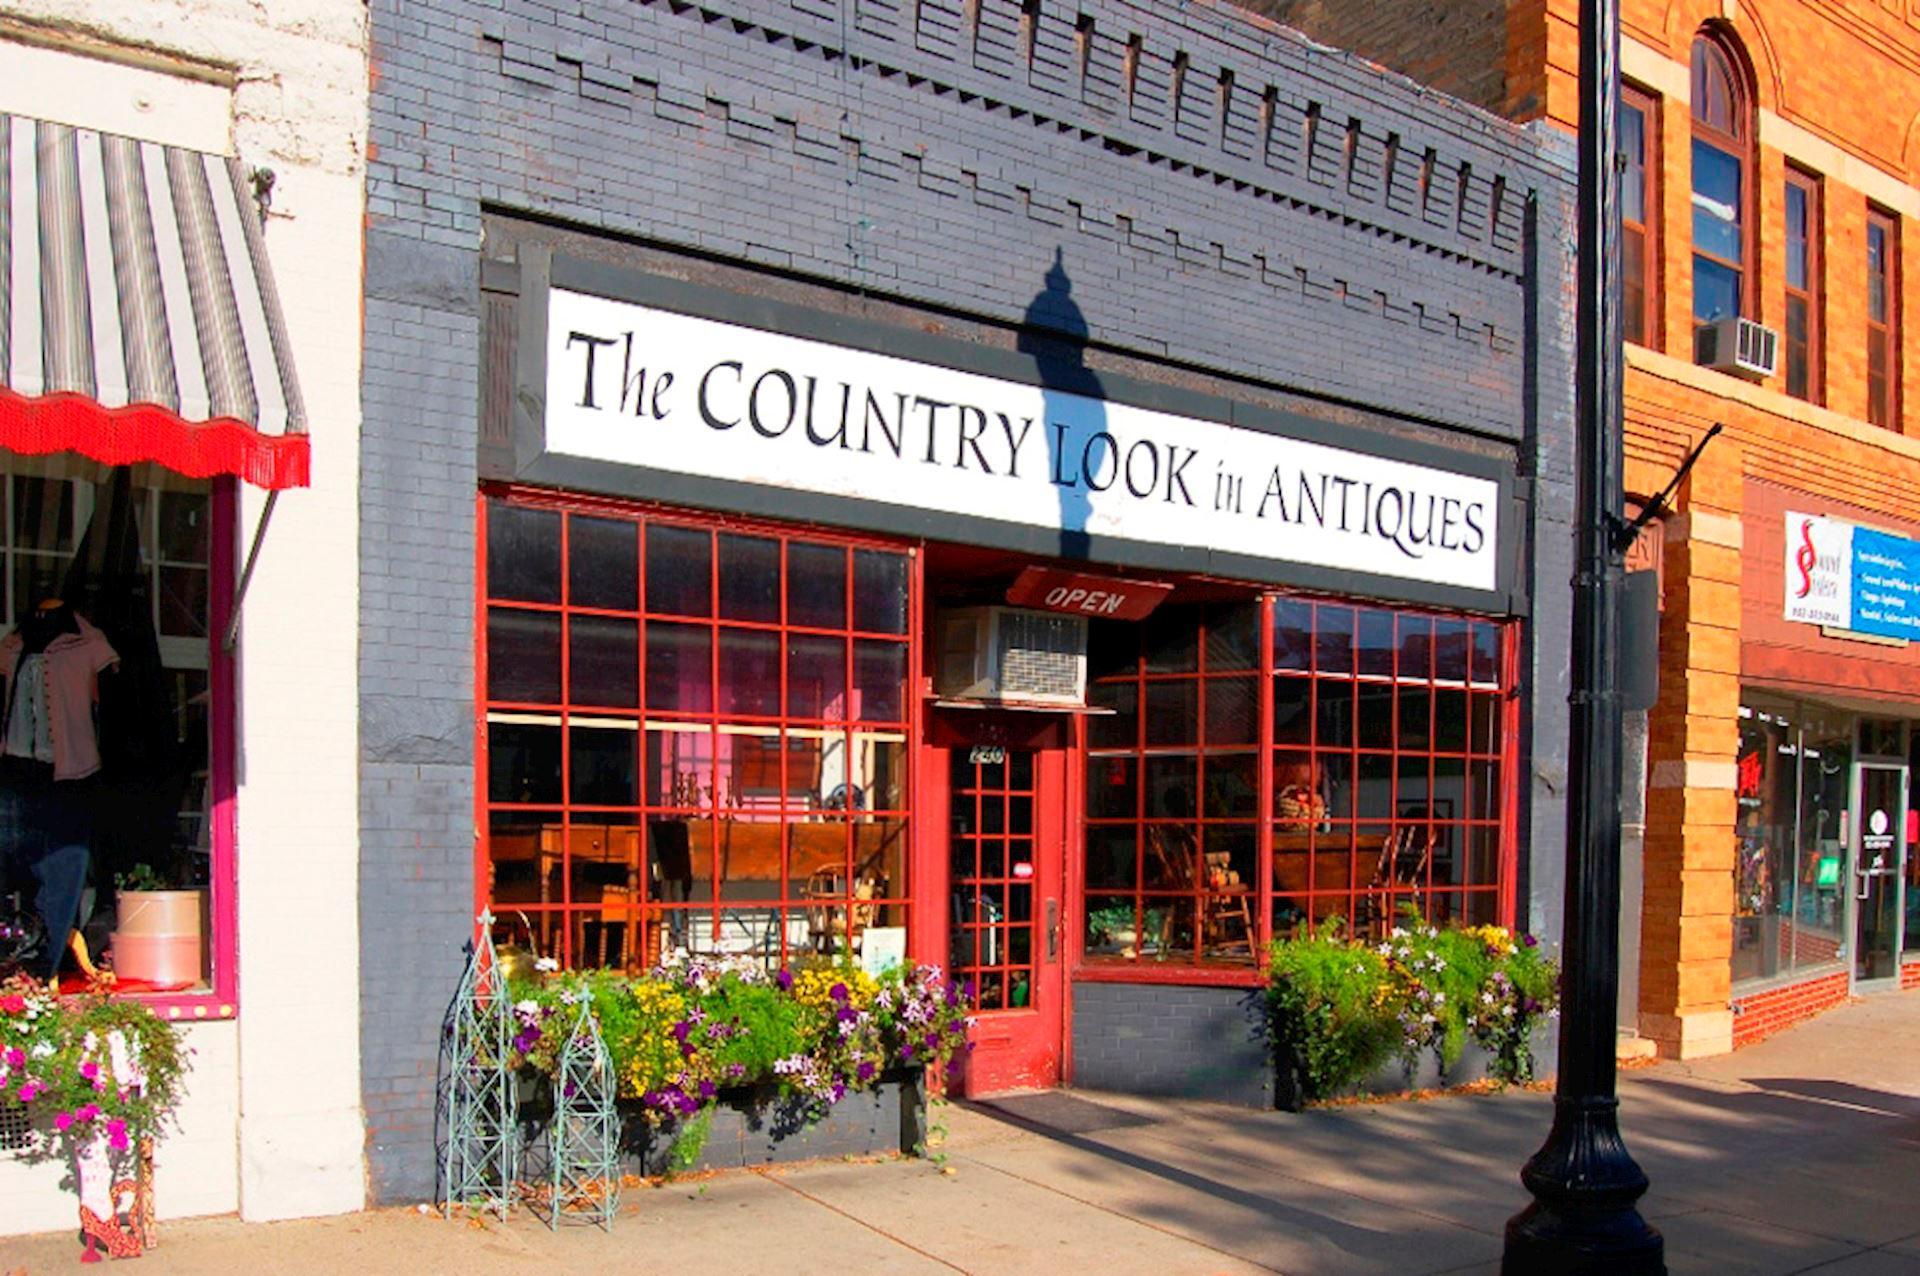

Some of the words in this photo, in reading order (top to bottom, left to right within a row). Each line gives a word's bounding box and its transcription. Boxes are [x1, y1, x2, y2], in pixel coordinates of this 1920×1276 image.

[566, 330, 674, 420] The
[698, 361, 1033, 478] COUNTRY
[1051, 423, 1199, 507] LOOK
[1214, 460, 1244, 514] in
[1256, 464, 1486, 559] ANTIQUES
[1045, 587, 1125, 614] OPEN
